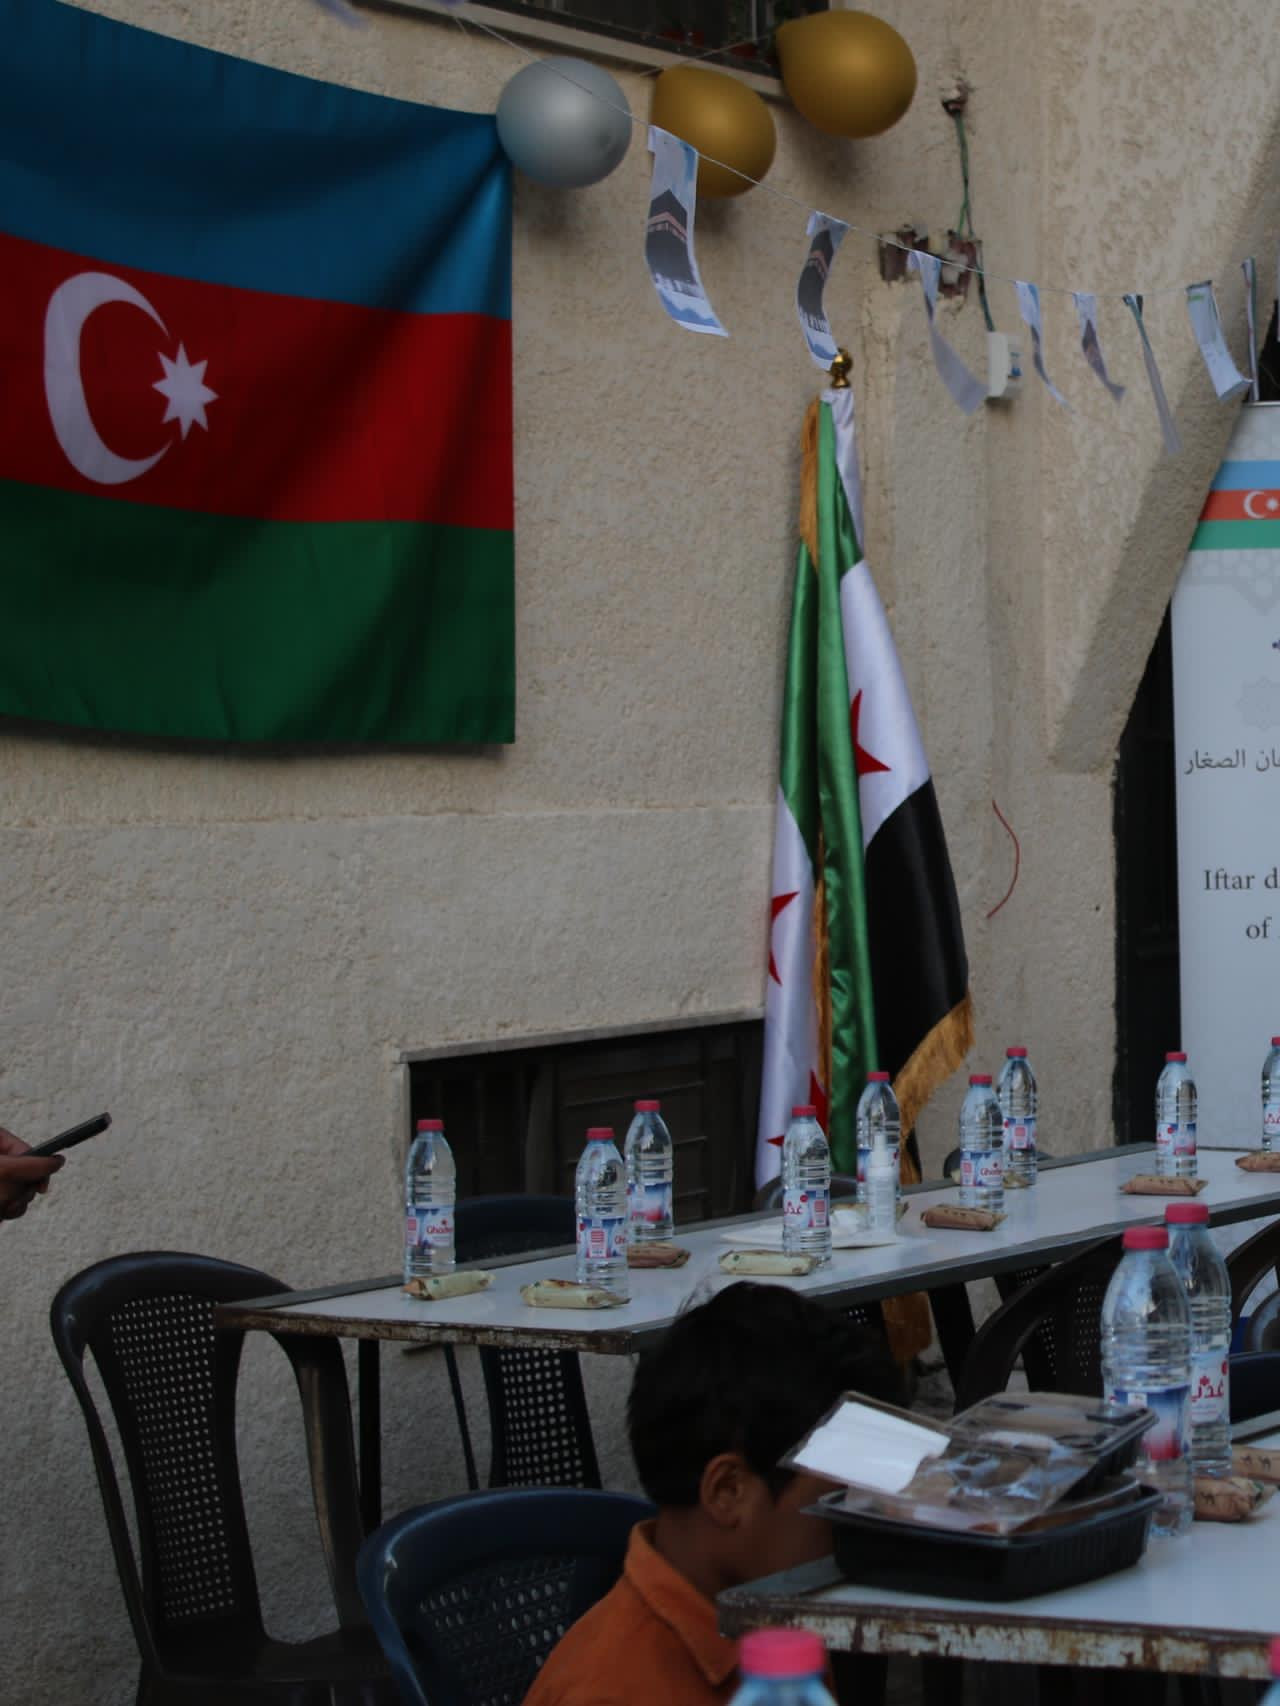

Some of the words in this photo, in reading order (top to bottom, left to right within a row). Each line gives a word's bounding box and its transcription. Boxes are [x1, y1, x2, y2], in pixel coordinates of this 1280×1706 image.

[1184, 748, 1247, 775] الصغار
[1203, 868, 1256, 891] Iftar
[1245, 916, 1273, 940] of
